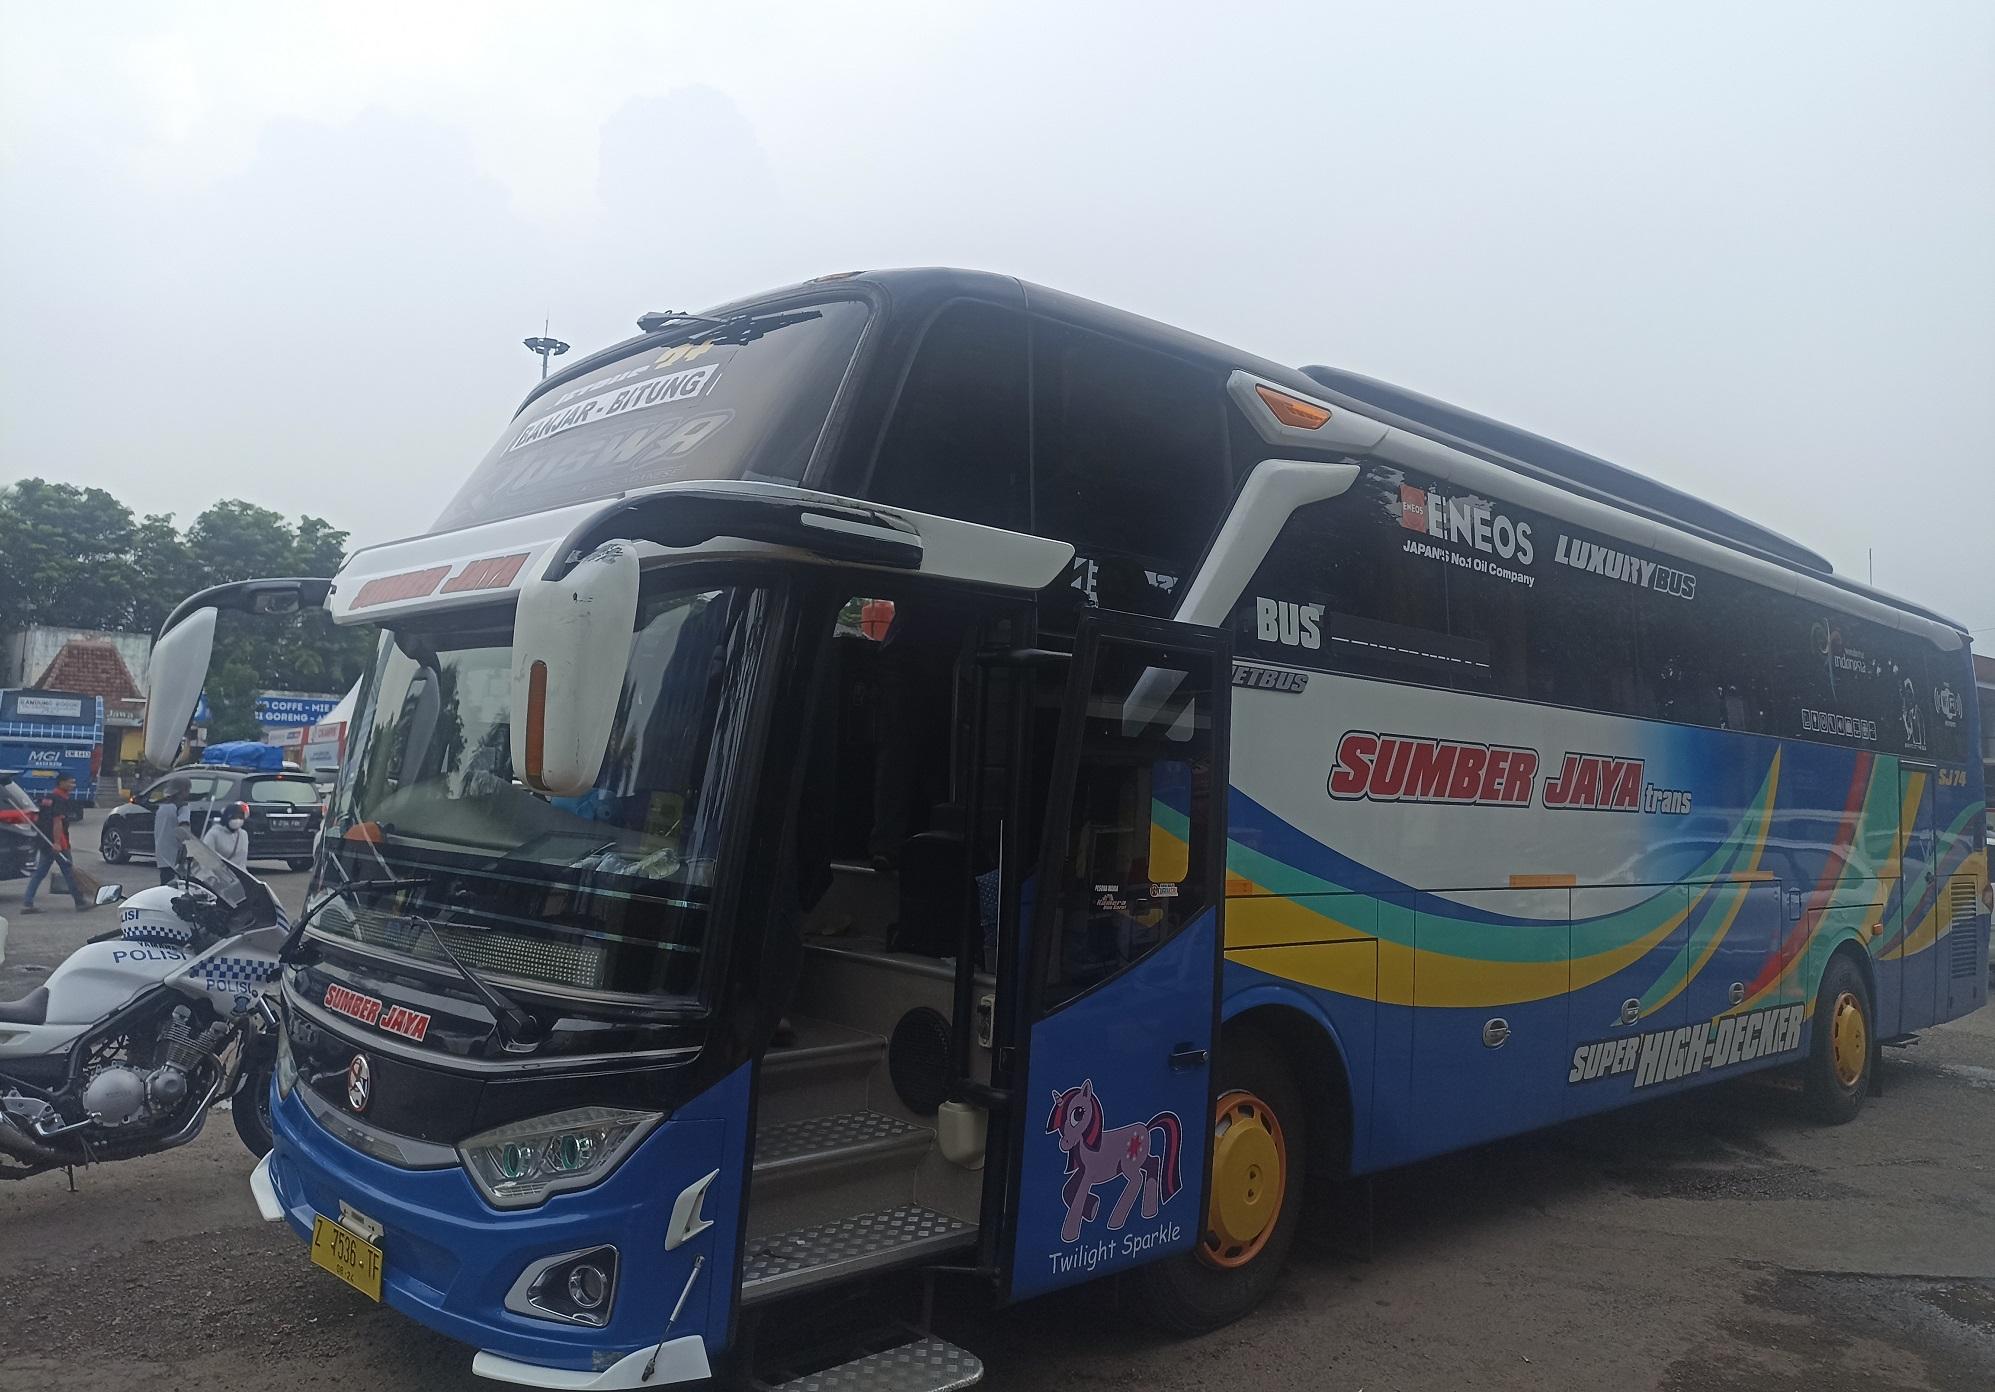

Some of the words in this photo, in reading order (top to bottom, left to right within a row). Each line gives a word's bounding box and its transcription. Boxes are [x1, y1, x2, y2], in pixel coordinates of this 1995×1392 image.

[517, 400, 599, 449] BANJAR
[606, 370, 706, 415] BITUNG
[1403, 501, 1424, 515] ENEOS
[1427, 492, 1534, 566] ENEOS
[1403, 540, 1450, 562] JAPAN'S
[1451, 552, 1472, 569] No.1
[1473, 559, 1488, 573] Oil
[1488, 562, 1535, 588] Company
[1554, 534, 1657, 588] LUXURY
[1653, 565, 1696, 600] BUS
[1256, 596, 1321, 650] BUS
[265, 711, 309, 722] GORENG
[271, 701, 304, 712] COFFE
[29, 750, 60, 761] MGI
[1327, 729, 1540, 808] SUMBER
[1543, 751, 1645, 813] JAYA
[1643, 783, 1692, 815] trans
[113, 949, 187, 963] POLISI
[206, 978, 251, 994] POLISI
[324, 983, 382, 1026] SUMBER
[380, 1004, 431, 1042] JAYA
[1568, 1036, 1641, 1083] SUPER
[1633, 1003, 1806, 1088] HIGH-DECKER
[314, 1218, 323, 1248] Z
[333, 1228, 357, 1267] 7536
[367, 1248, 379, 1281] TF
[1049, 1240, 1116, 1274] Twilight
[1121, 1221, 1181, 1258] Sparkle
